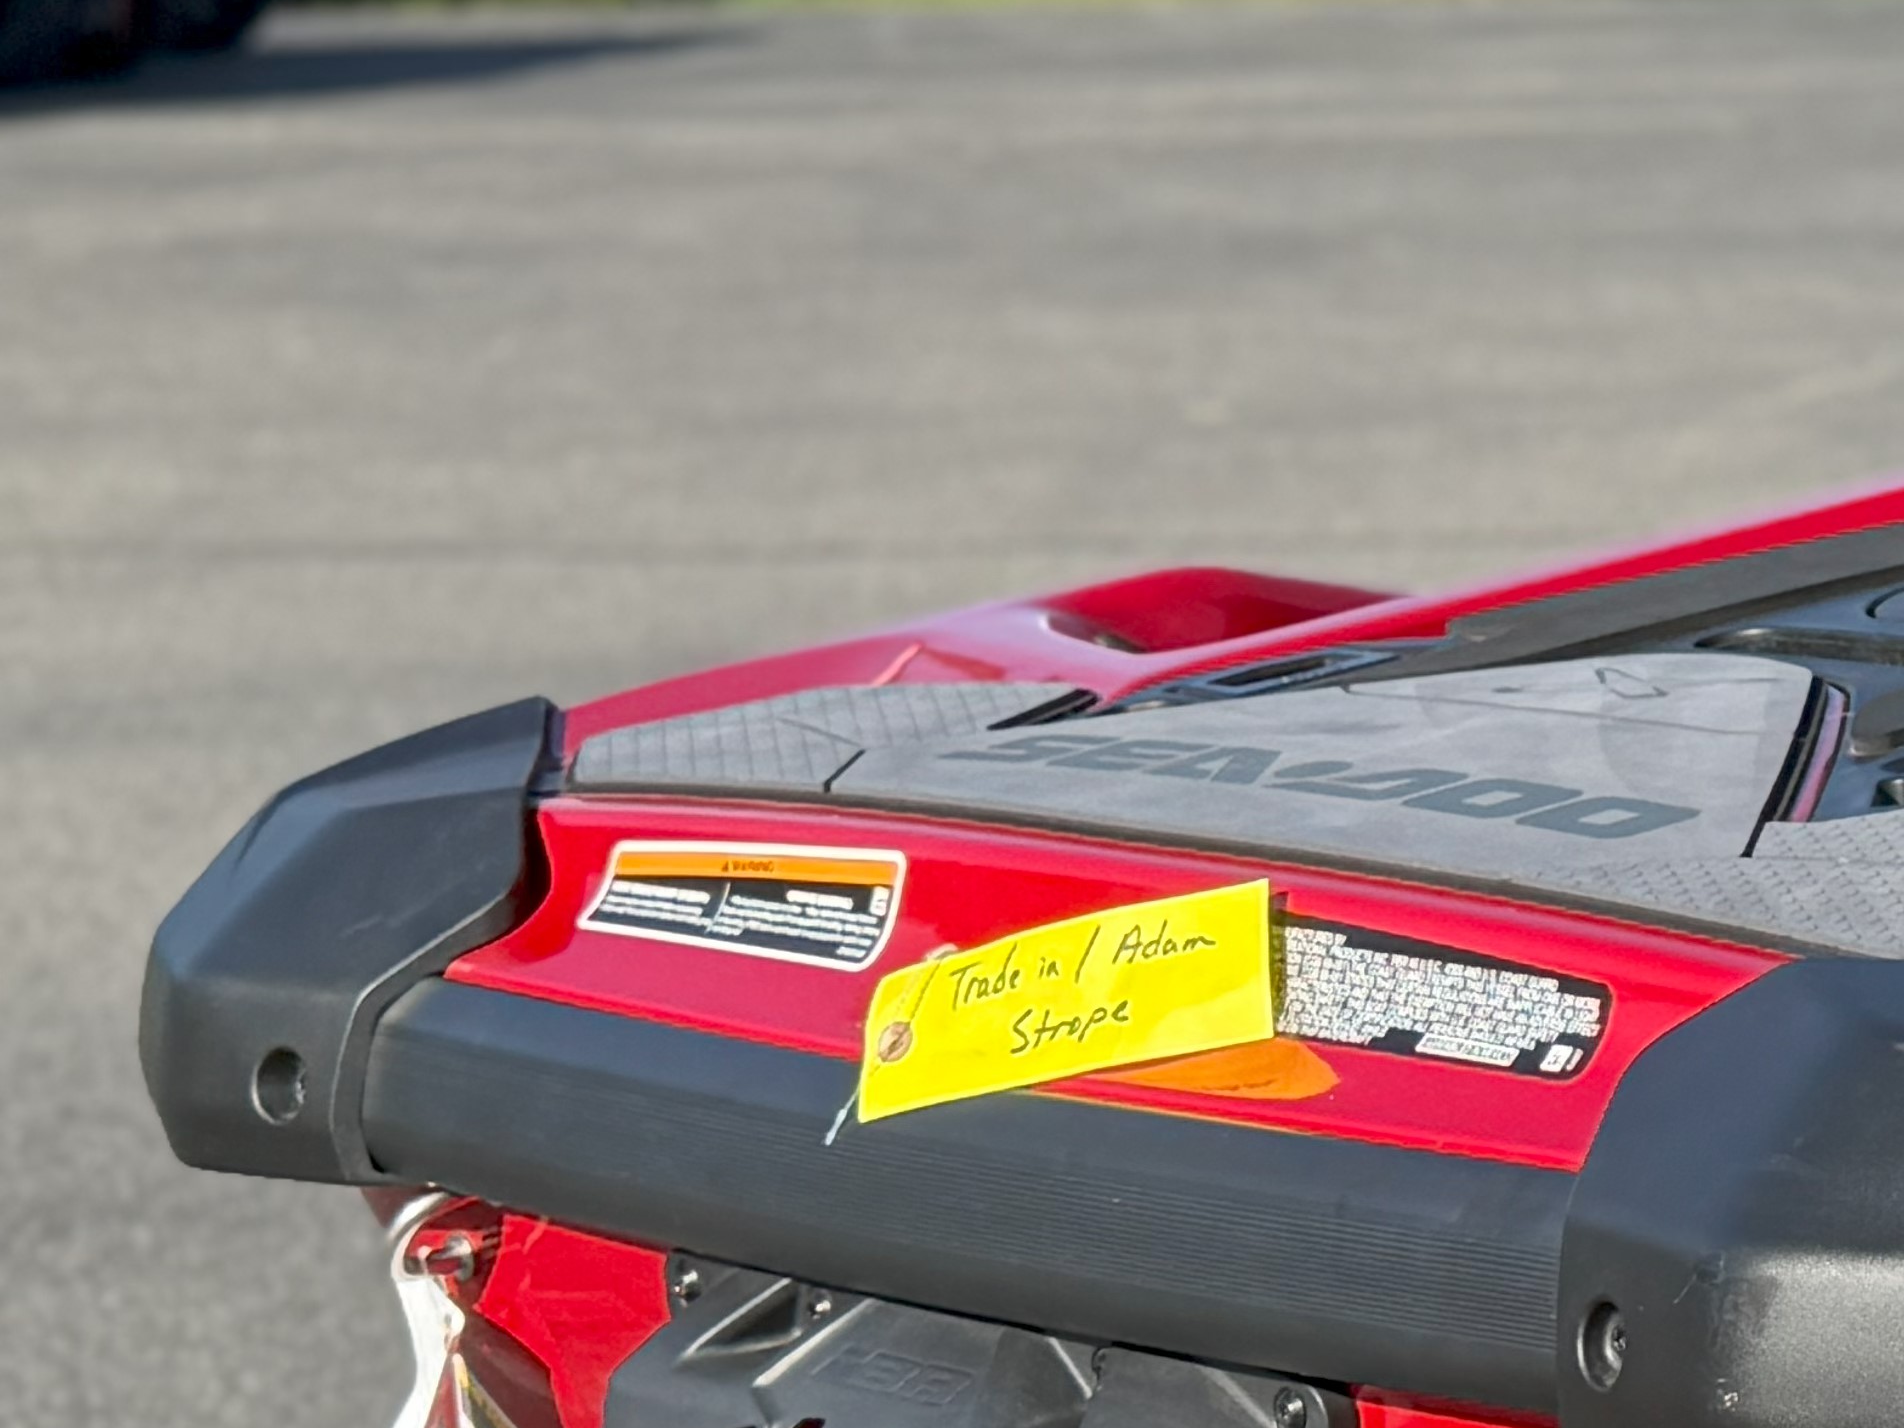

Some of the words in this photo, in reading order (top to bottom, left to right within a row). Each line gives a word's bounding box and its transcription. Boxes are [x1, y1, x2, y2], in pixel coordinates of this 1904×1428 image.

[949, 941, 1020, 1011] Trade
[1037, 956, 1060, 979] in
[1112, 919, 1216, 965] Adam
[1010, 999, 1130, 1055] Strope
